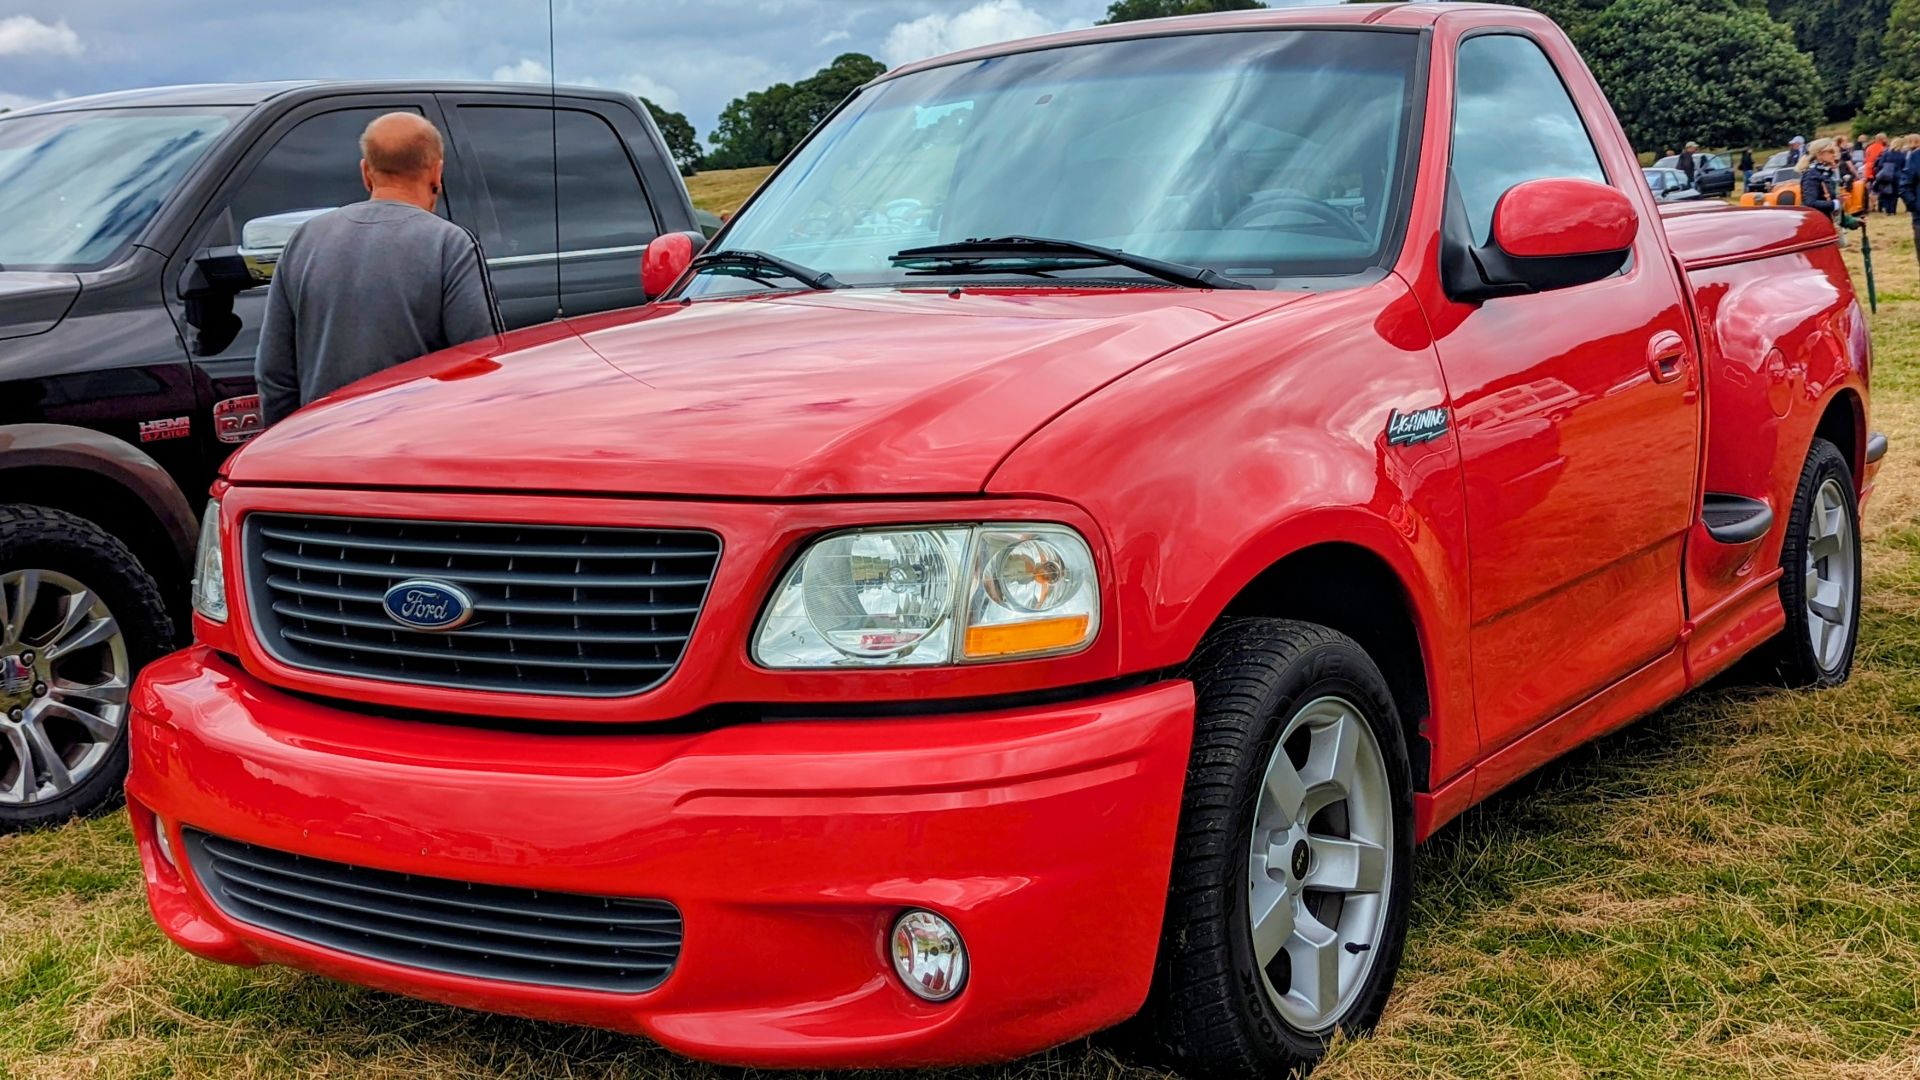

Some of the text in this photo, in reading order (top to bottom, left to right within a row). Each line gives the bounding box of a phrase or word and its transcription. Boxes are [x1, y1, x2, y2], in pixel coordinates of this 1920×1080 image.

[138, 416, 190, 430] HEMI
[220, 414, 258, 430] RA
[1389, 409, 1446, 434] LIGHTNING
[161, 428, 190, 439] LITER
[401, 590, 448, 619] Ford
